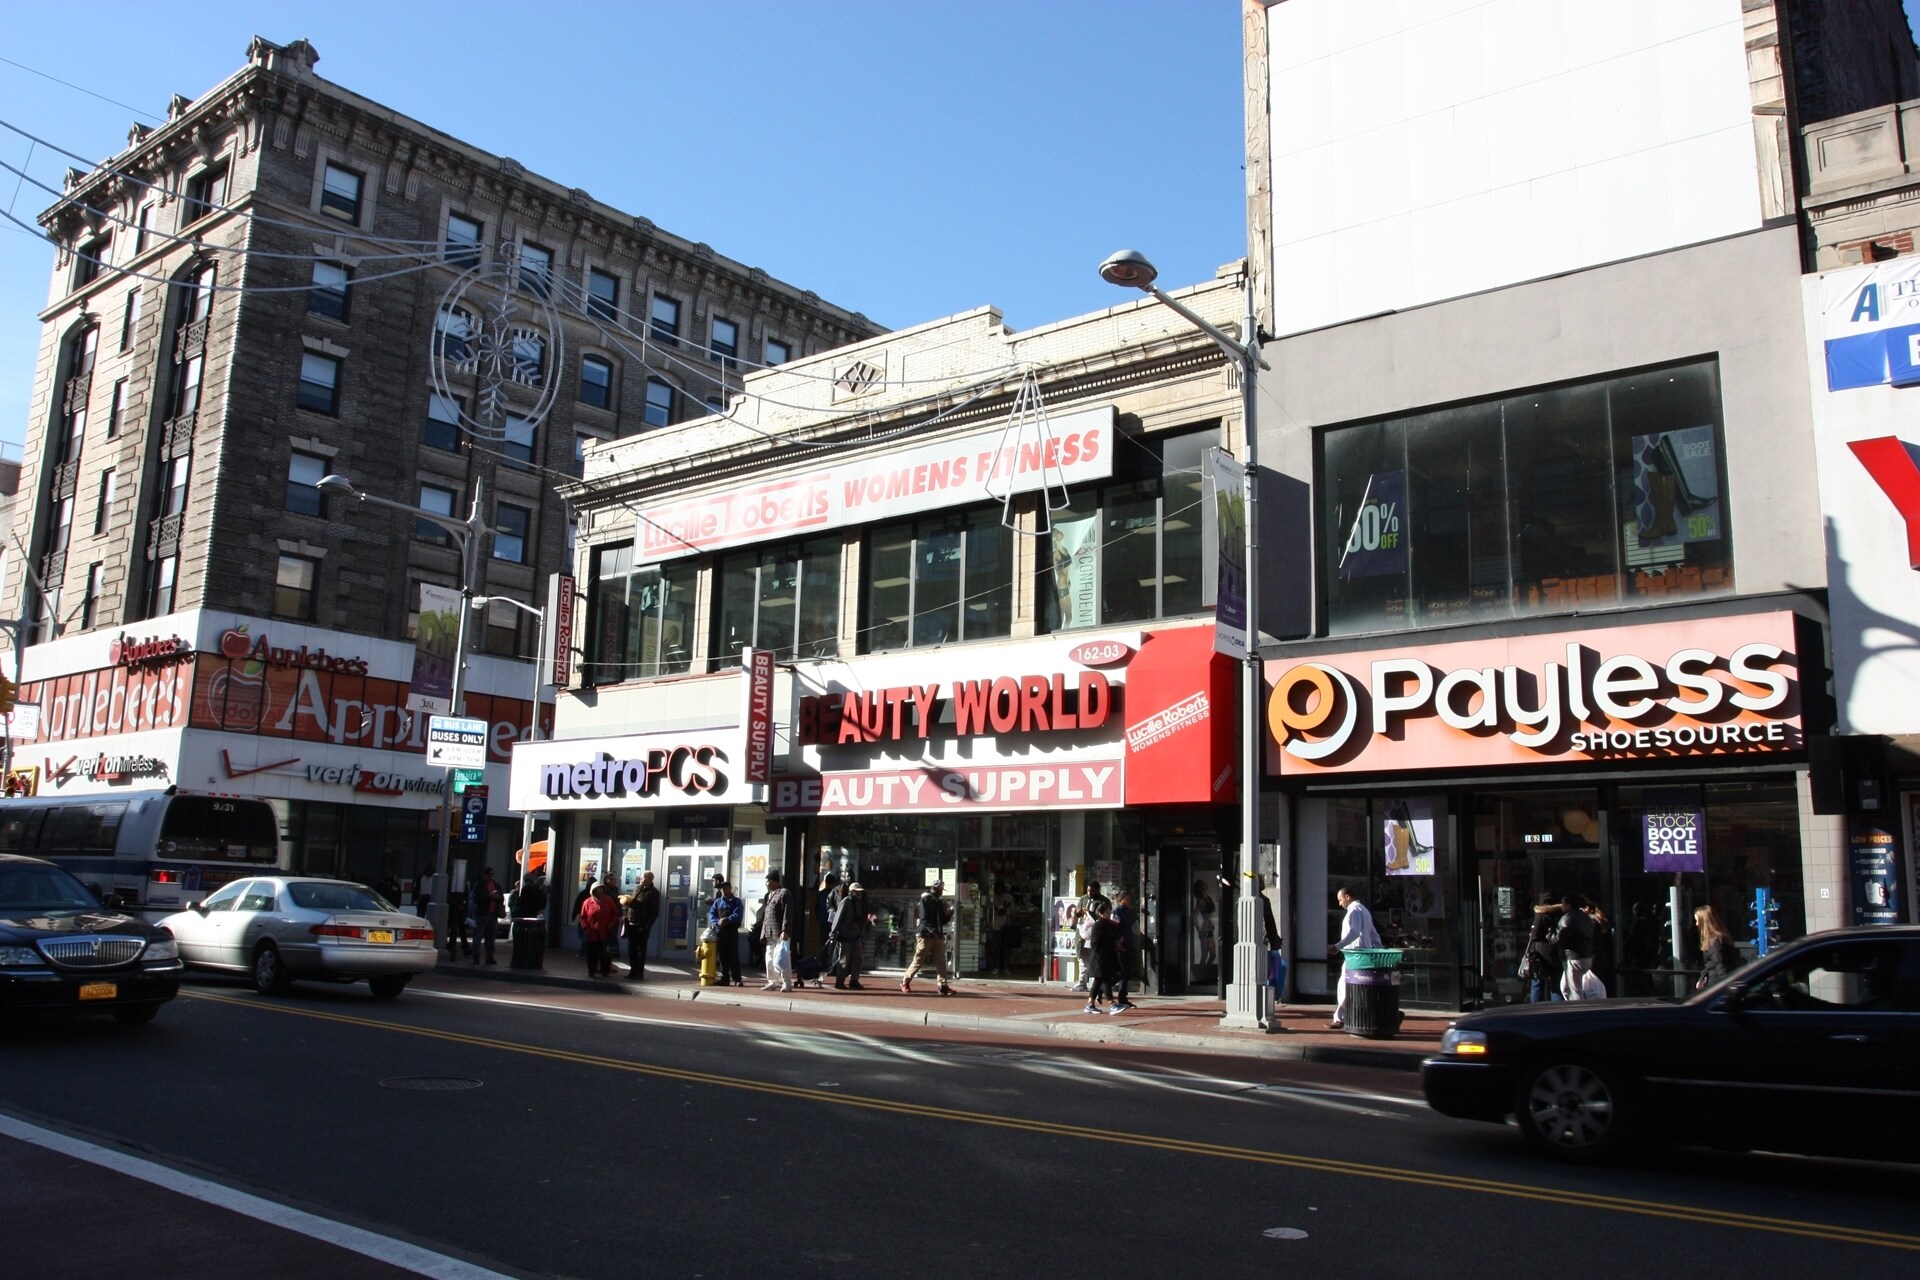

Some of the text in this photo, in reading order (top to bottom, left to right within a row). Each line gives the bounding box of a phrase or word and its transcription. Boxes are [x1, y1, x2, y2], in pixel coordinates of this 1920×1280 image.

[1683, 440, 1711, 451] BOOT
[1683, 448, 1711, 459] SALE
[844, 429, 1100, 508] WOMENS FITNESS
[643, 511, 717, 549] Lucille
[1381, 533, 1399, 549] OFF
[1078, 555, 1094, 624] CONFIDENT
[557, 576, 572, 683] Lucille Roberts
[121, 636, 178, 666] Applebee's
[251, 634, 368, 676] Applebee's
[1077, 644, 1119, 661] 162-03
[799, 671, 1111, 747] BEAUTY WORLD
[1371, 642, 1789, 748] Payless
[443, 721, 484, 732] BUS LANE
[750, 655, 769, 780] BEAUTY SUPPLY
[1127, 696, 1209, 743] Lucille Roberts
[1131, 710, 1210, 753] WOMENS FITNESS
[432, 731, 484, 744] BUSES ONLY
[1570, 721, 1785, 752] SHOESOURCE
[454, 770, 477, 781] Jamaica
[540, 744, 717, 796] metroPCS
[776, 766, 1115, 808] BEAUTY SUPPLY
[1647, 816, 1696, 827] STOCK
[1648, 827, 1696, 840] BOOT
[1648, 840, 1697, 855] SALE
[1869, 835, 1893, 843] PRICES
[585, 862, 598, 873] 4G
